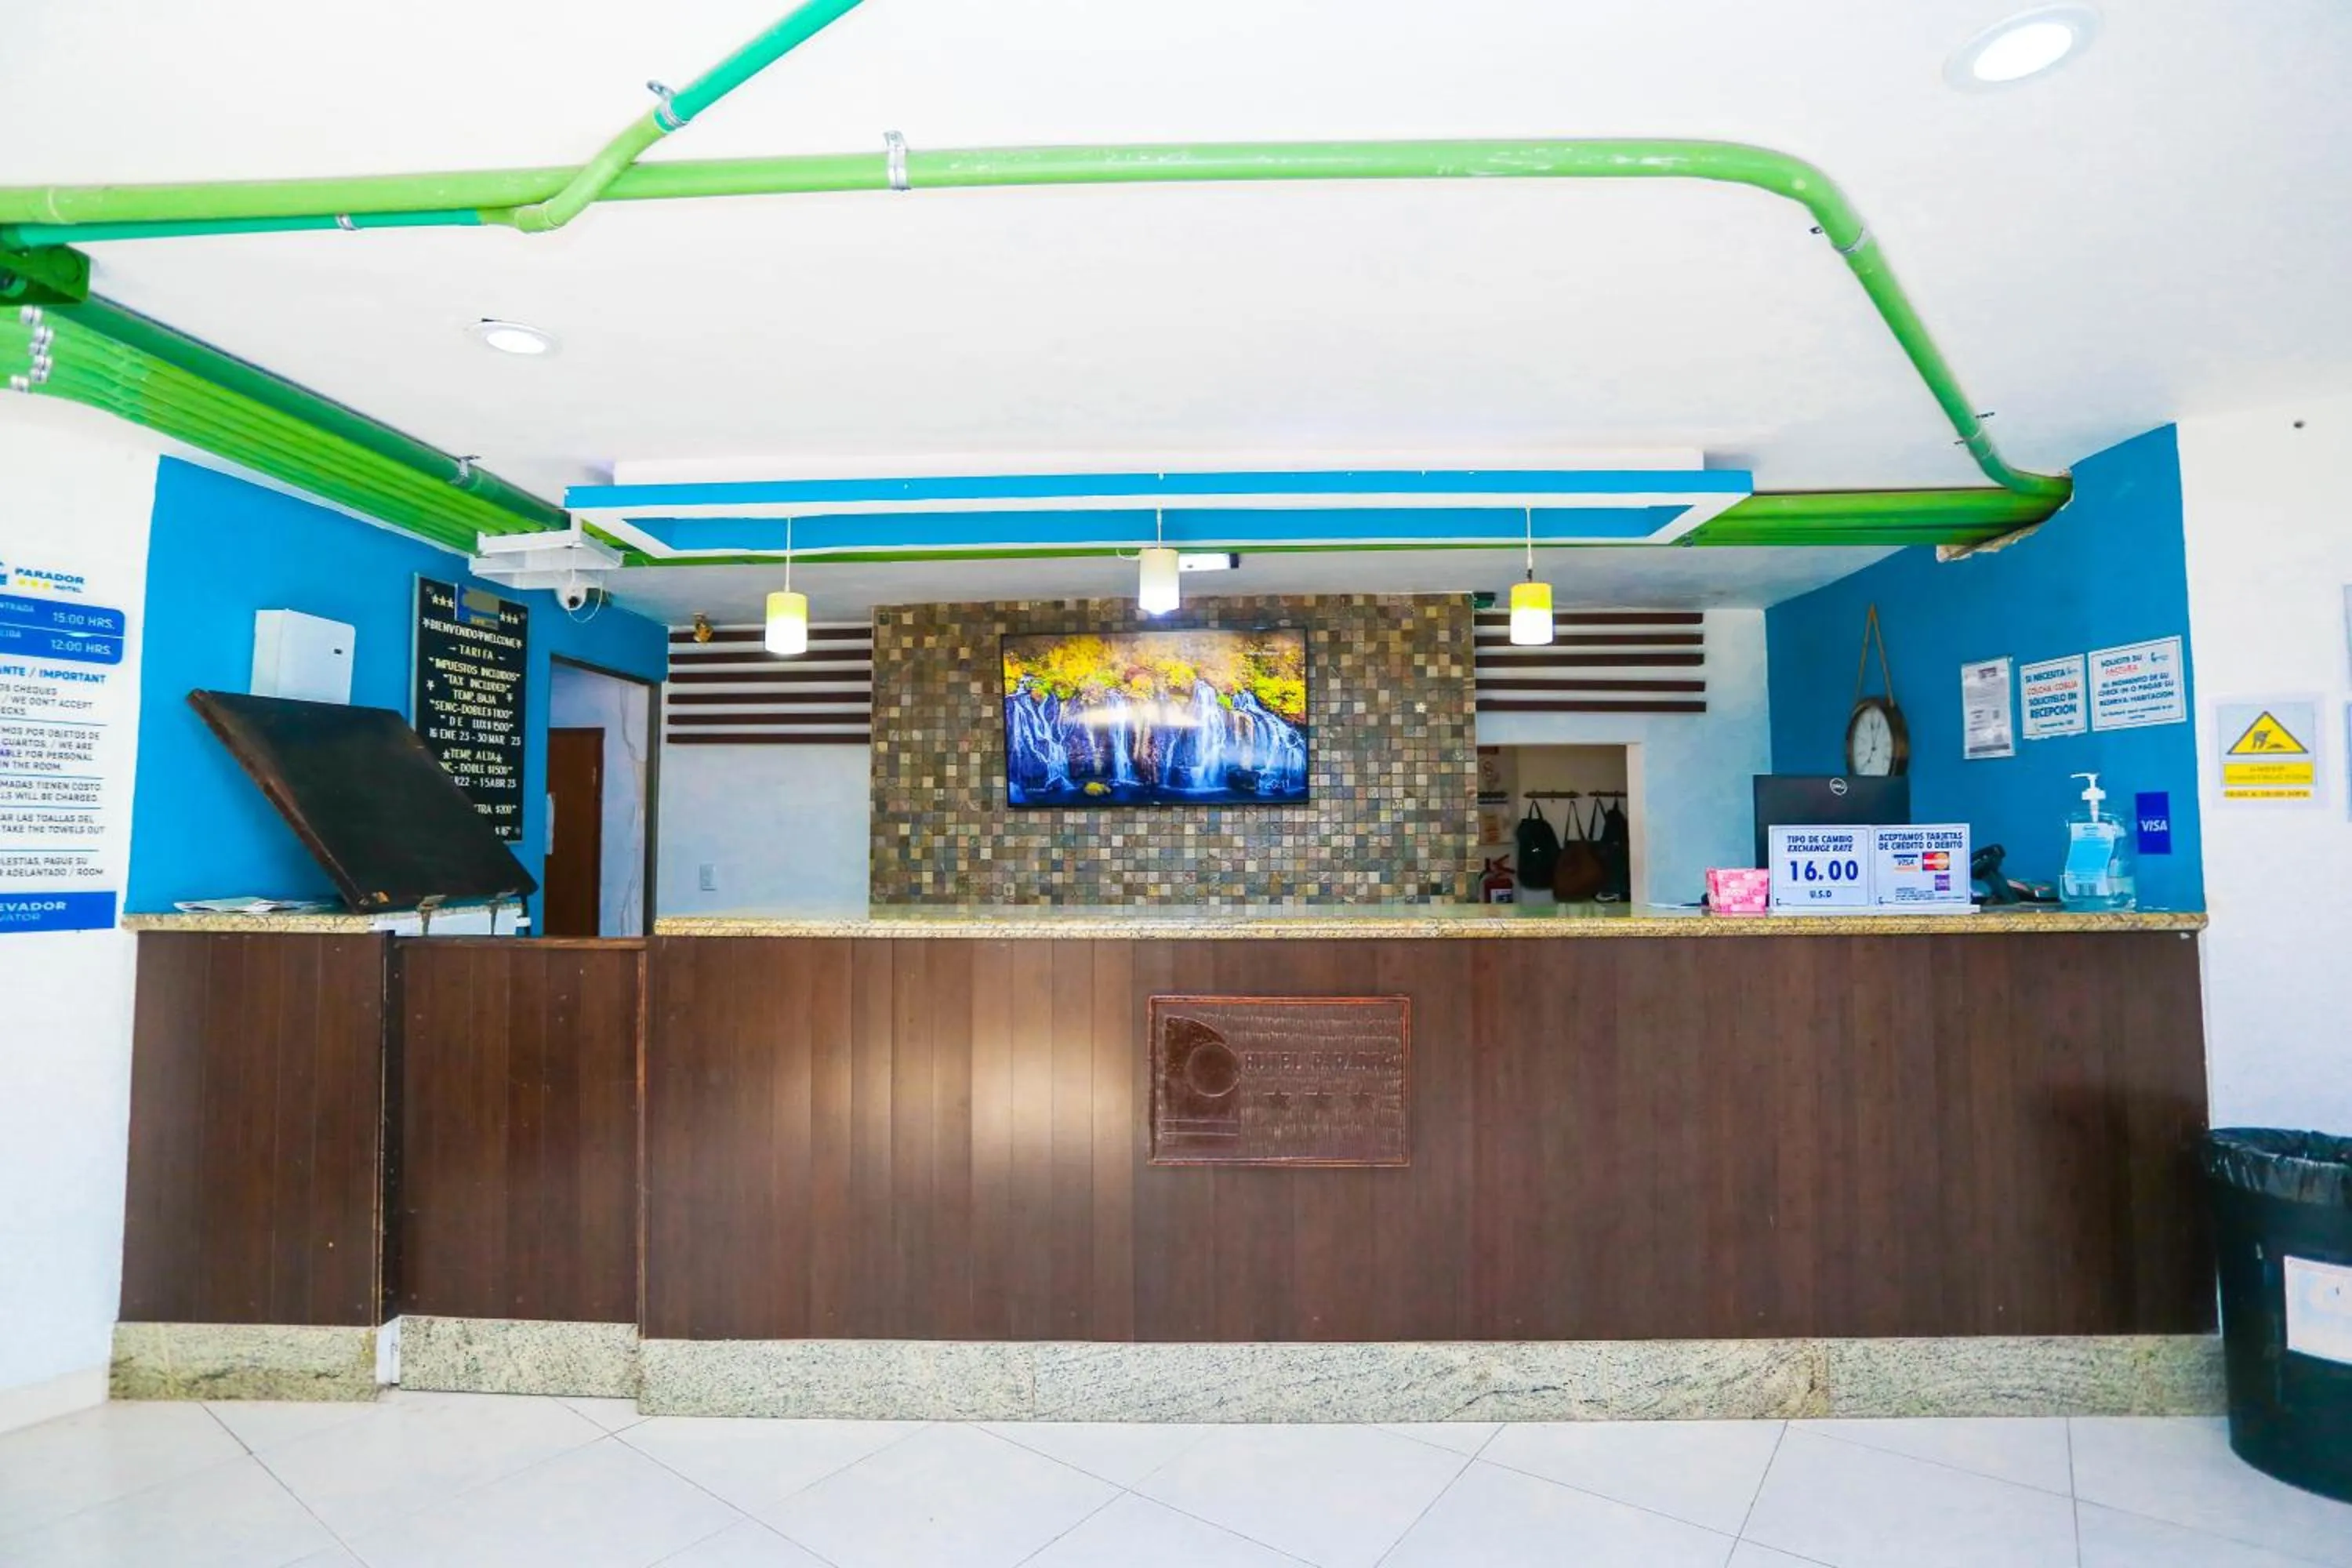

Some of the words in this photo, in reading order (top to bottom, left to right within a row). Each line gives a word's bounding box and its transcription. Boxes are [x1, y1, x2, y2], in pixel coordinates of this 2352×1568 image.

[16, 568, 85, 585] PARADOR
[53, 612, 85, 625] 15:00
[51, 639, 82, 652] 12:00
[39, 668, 107, 684] IMPORTANT
[13, 684, 57, 696] CHEQUES
[12, 695, 27, 706] WE
[60, 699, 93, 710] ACCEPT
[26, 728, 45, 737] POR
[48, 729, 86, 739] OBJETOS
[88, 731, 101, 741] DE
[59, 741, 73, 750] WE
[75, 742, 93, 750] ARE
[25, 750, 44, 760] FOR
[47, 751, 94, 762] PERSONAL
[13, 760, 31, 770] THE
[37, 780, 70, 790] TIENEN
[16, 792, 38, 801] WILL
[42, 793, 53, 801] BE
[16, 814, 34, 823] LAS
[37, 814, 76, 823] TOALLAS
[78, 815, 95, 824] DEL
[2, 825, 25, 834] TAKE
[28, 825, 45, 834] THE
[48, 826, 85, 835] TOWELS
[87, 826, 106, 835] OUT
[2140, 819, 2168, 833] VISA
[1788, 835, 1806, 844] TIPO
[1821, 834, 1854, 844] CAMBIO
[1878, 833, 1924, 841] ACEPTAMOS
[1926, 831, 1963, 840] TARJETAS
[1787, 844, 1831, 852] EXCHANGE
[1832, 844, 1853, 852] RATE
[44, 856, 73, 866] PAGUE
[76, 857, 89, 866] SU
[6, 868, 67, 877] ADELANTADO
[76, 867, 104, 877] ROOM
[1790, 860, 1859, 881] 16.00
